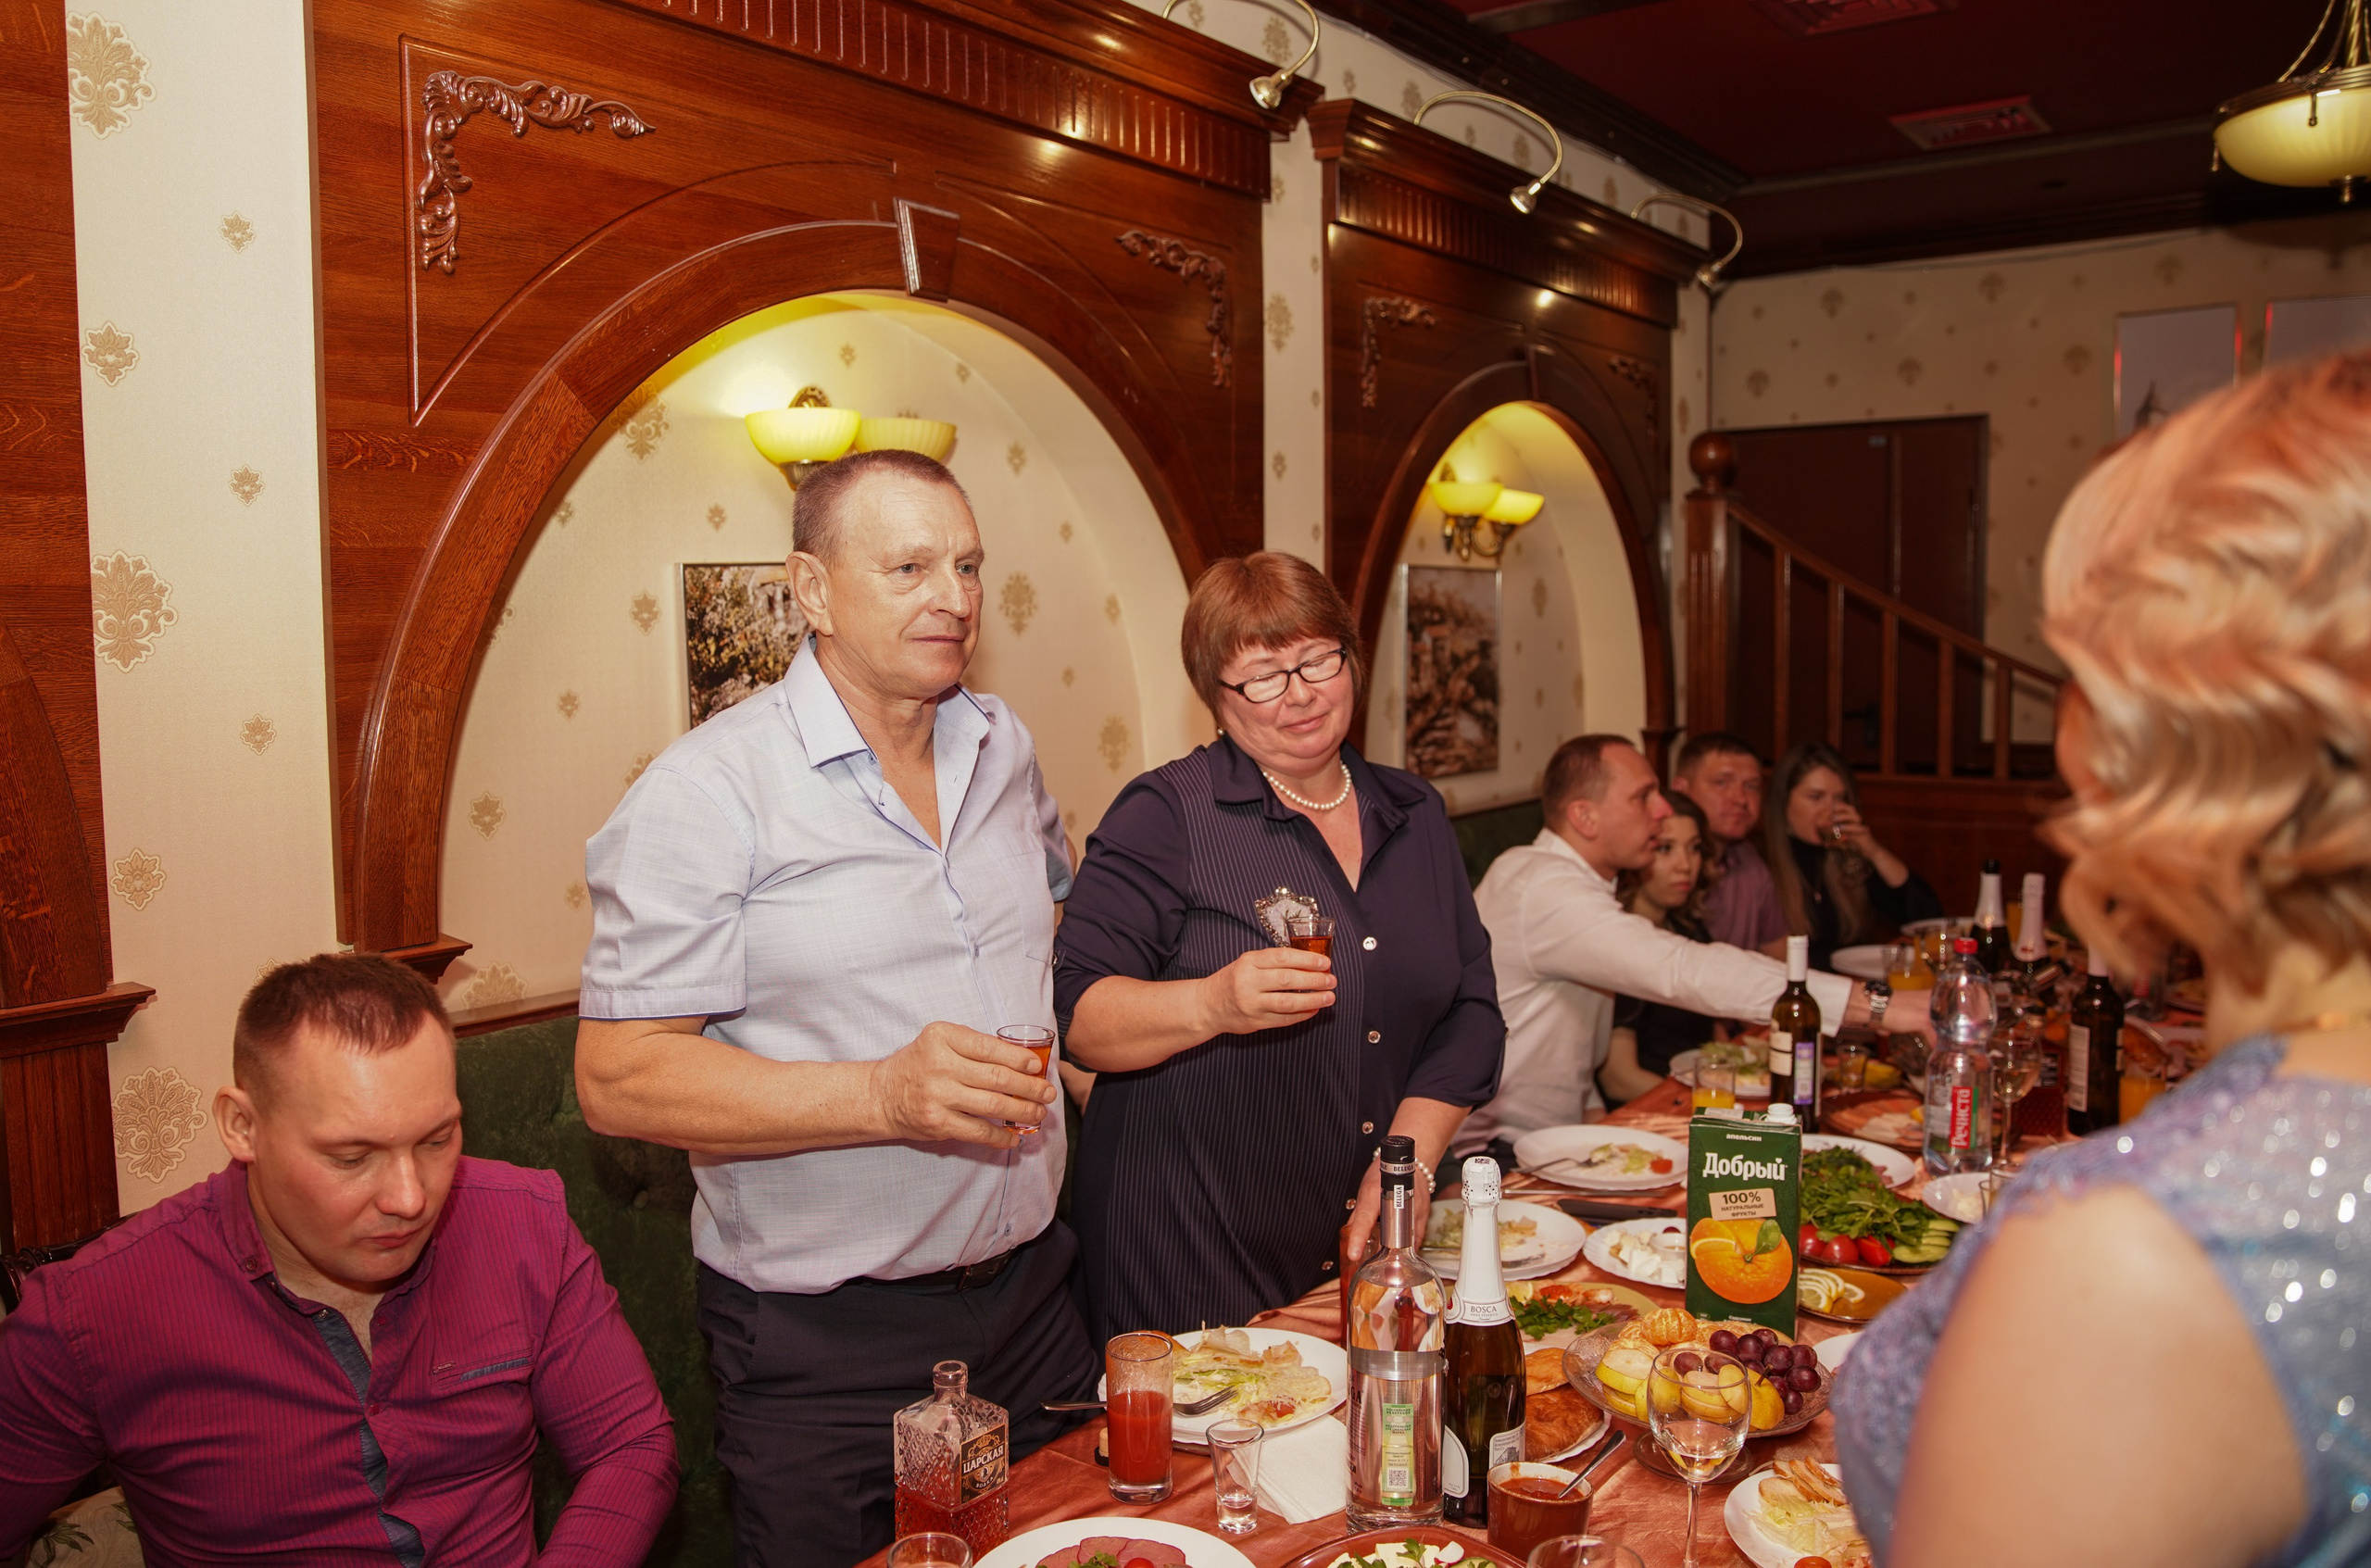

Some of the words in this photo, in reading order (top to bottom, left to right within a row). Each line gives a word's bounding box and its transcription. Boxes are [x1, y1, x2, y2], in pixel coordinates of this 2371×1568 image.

[1951, 1088, 1971, 1147] Речиста
[1725, 1133, 1763, 1142] апельсин
[1702, 1152, 1786, 1181] Добрый
[1723, 1191, 1761, 1204] 100%
[963, 1445, 1004, 1474] ЦАРСКАЯ
[975, 1476, 994, 1488] ВОДКА
